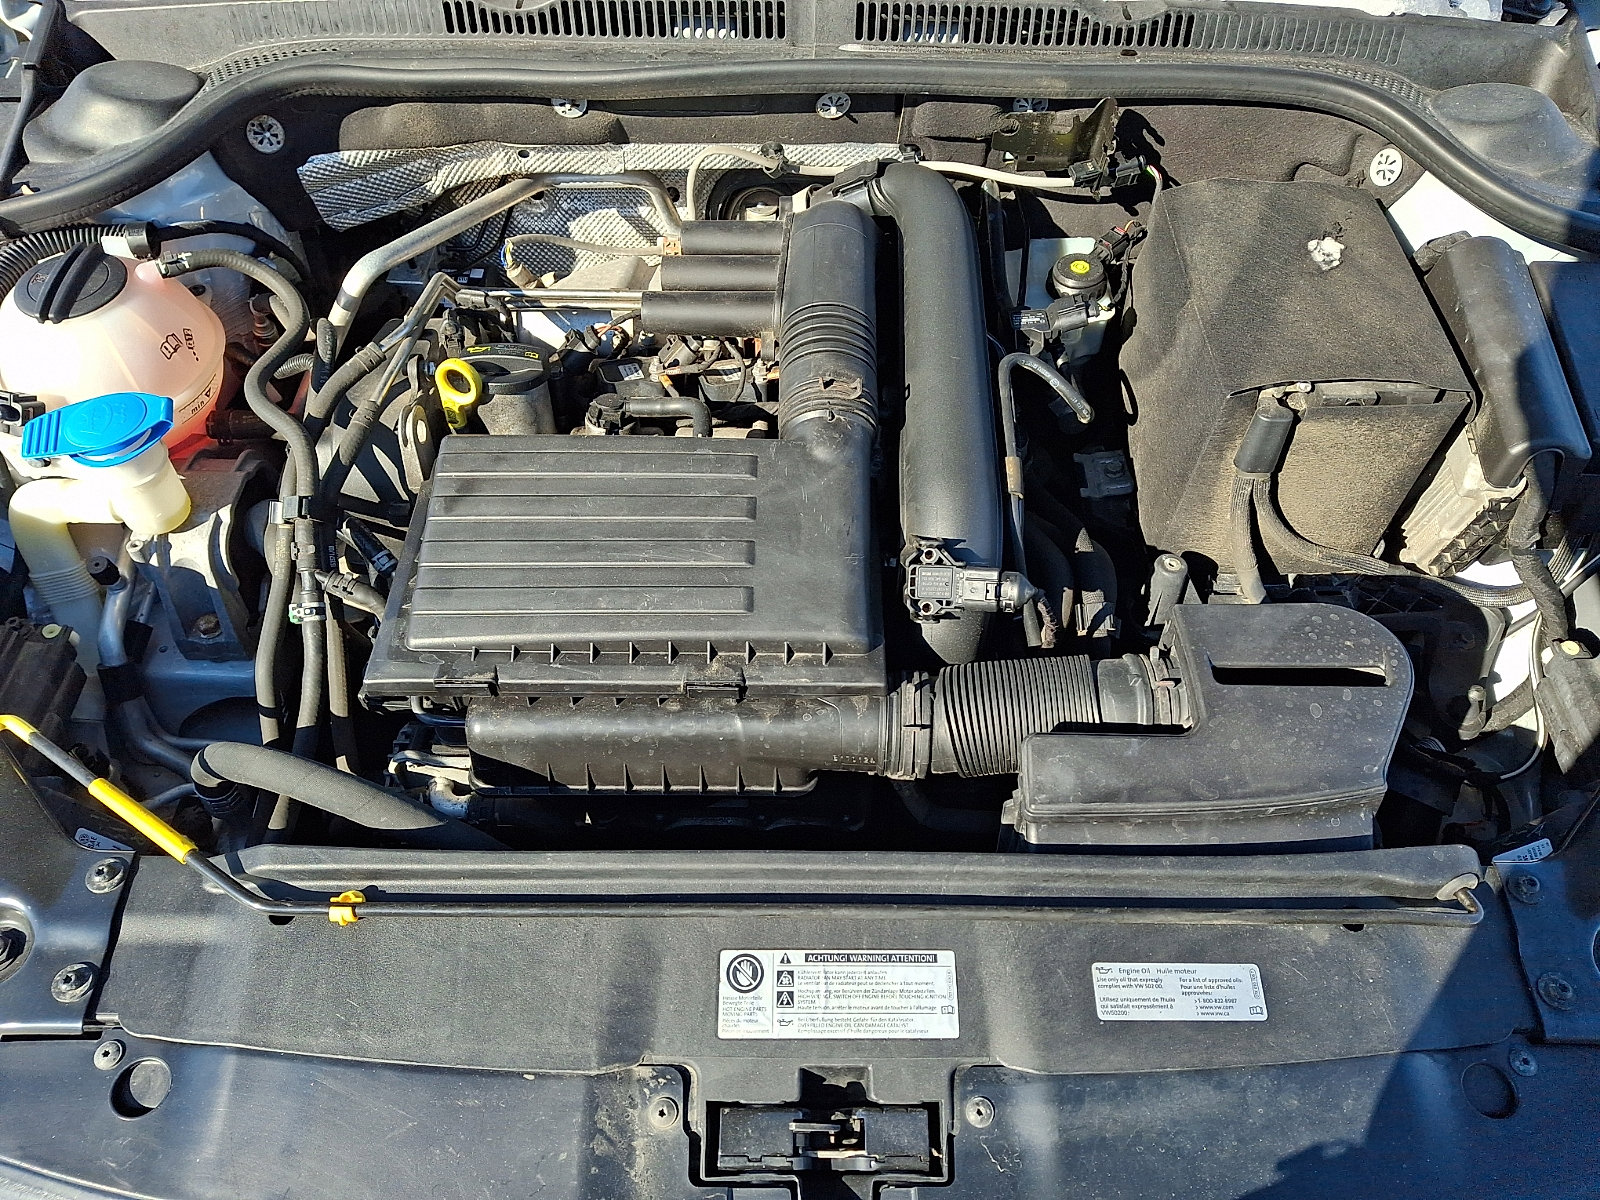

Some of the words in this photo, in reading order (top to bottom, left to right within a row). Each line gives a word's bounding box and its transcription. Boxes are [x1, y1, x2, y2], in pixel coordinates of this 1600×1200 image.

[191, 400, 205, 414] min
[807, 954, 848, 962] ACHTUNG!
[849, 954, 889, 962] WARNING!
[890, 955, 935, 963] ATTENTION!
